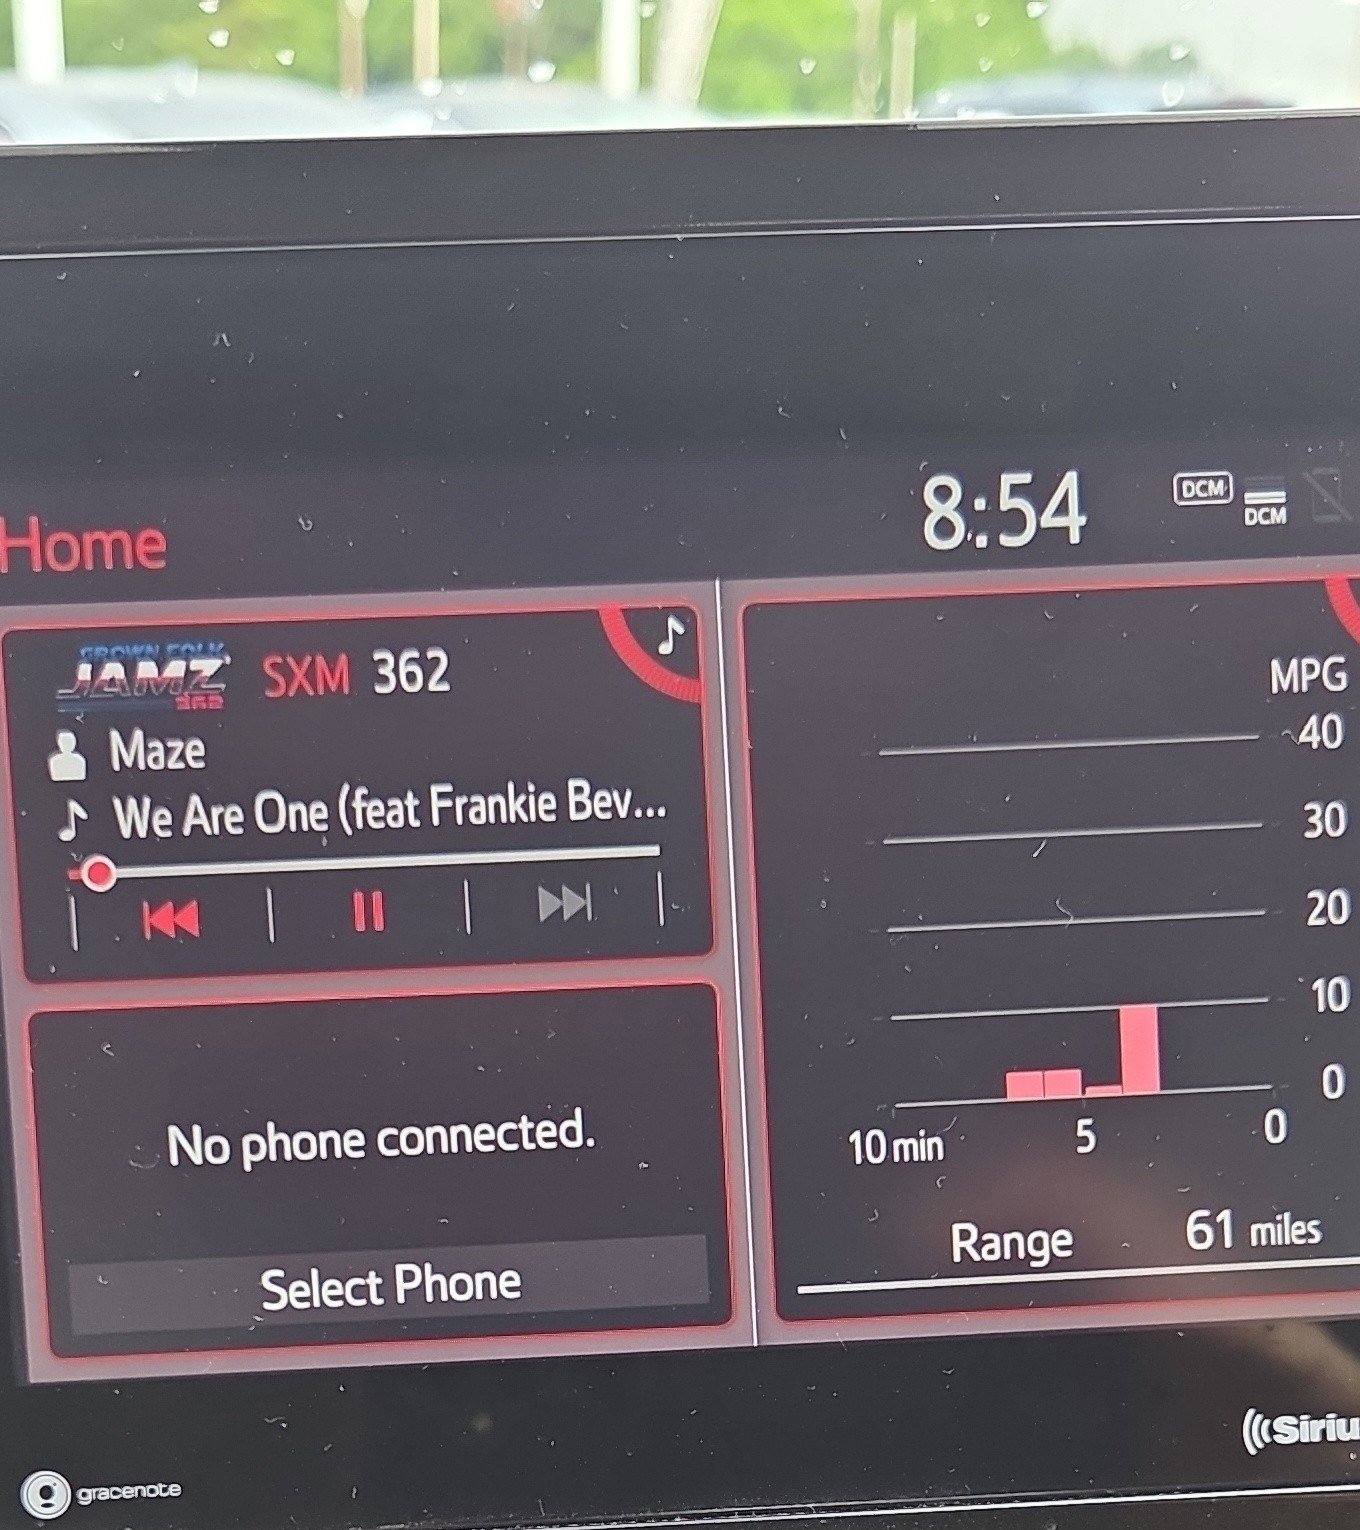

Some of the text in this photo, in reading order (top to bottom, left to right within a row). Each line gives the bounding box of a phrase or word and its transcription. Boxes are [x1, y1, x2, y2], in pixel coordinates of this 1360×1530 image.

[1182, 480, 1224, 498] DCM
[923, 470, 1086, 550] 8:54
[1245, 508, 1286, 526] DCM
[262, 647, 451, 698] SXM 362
[1271, 656, 1348, 694] MPG
[1298, 712, 1345, 749] 40
[110, 728, 206, 771] Maze
[113, 796, 172, 839] We
[183, 793, 244, 837] Are
[254, 789, 328, 834] One
[339, 782, 420, 835] (feat
[430, 781, 556, 826] Frankie
[1304, 801, 1347, 838] 30
[1307, 888, 1350, 926] 20
[1312, 976, 1350, 1013] 10
[1322, 1064, 1345, 1099] 0
[168, 1107, 595, 1171] No phone connected.
[1076, 1119, 1096, 1153] 5
[1264, 1108, 1288, 1144] 0
[849, 1129, 944, 1164] 10 min
[952, 1223, 1073, 1267] Range
[1186, 1209, 1322, 1250] 61 miles
[261, 1263, 521, 1310] Select Phone
[76, 1482, 182, 1505] gracenote
